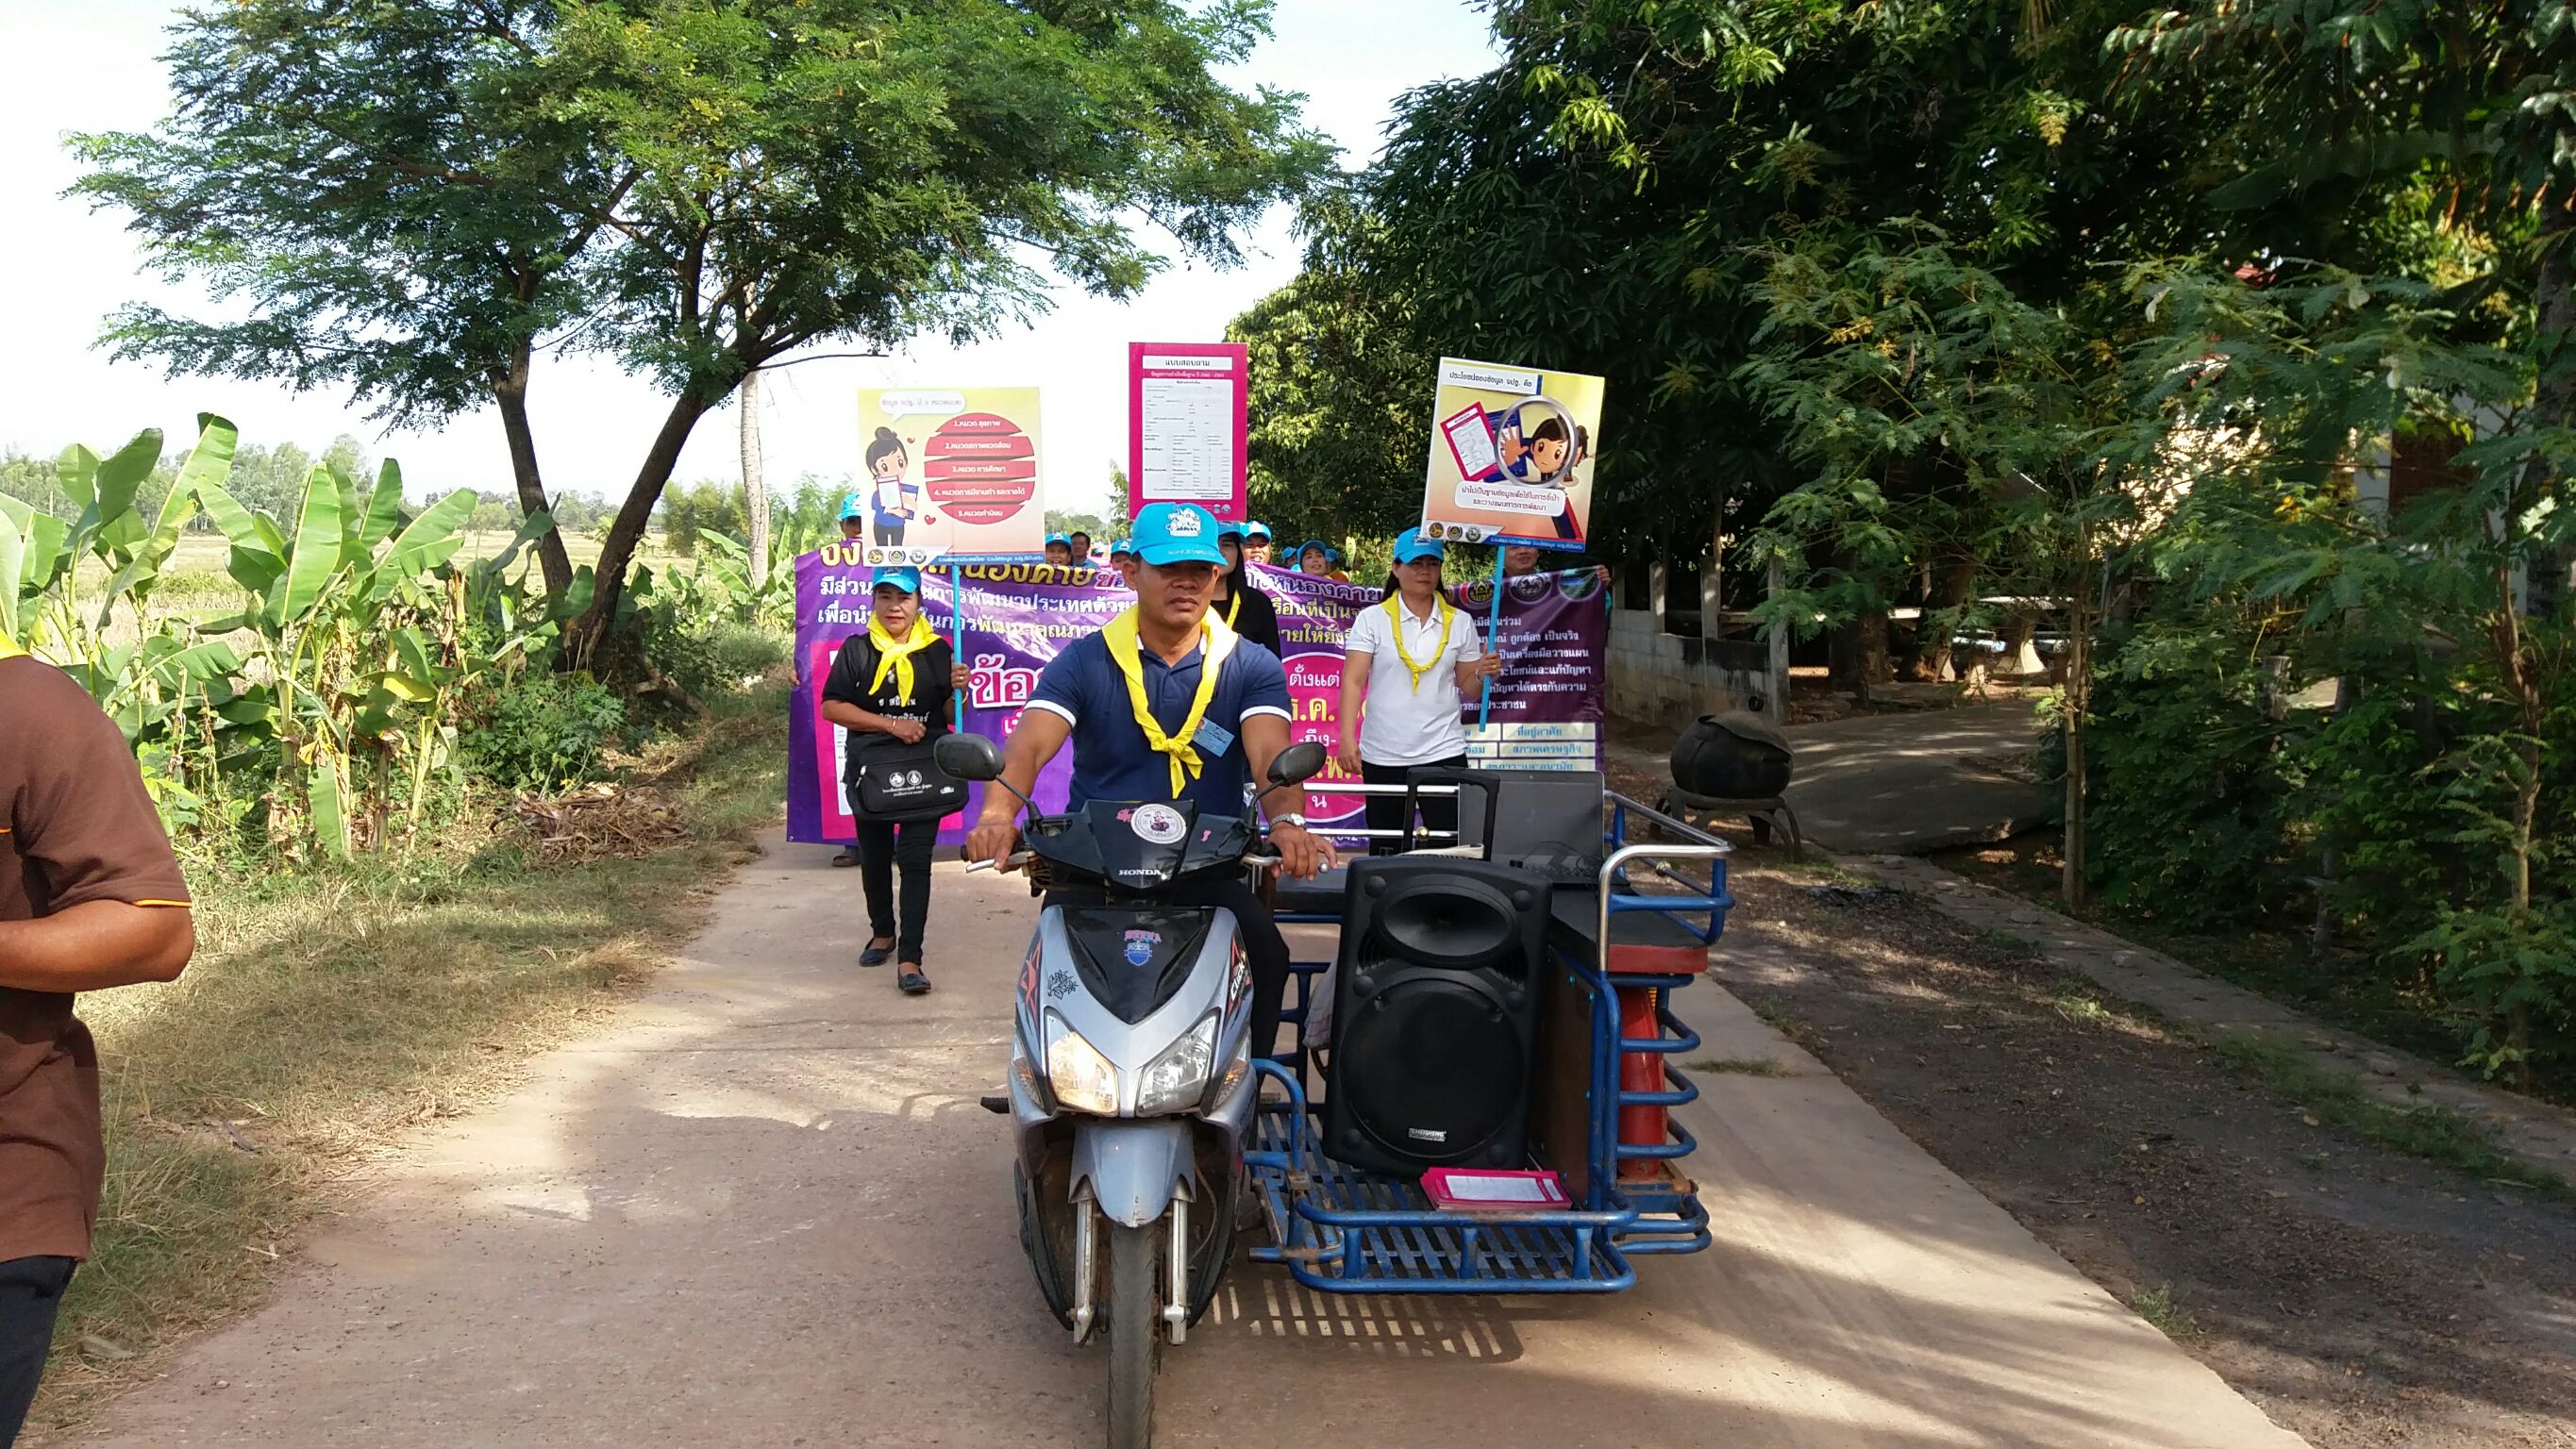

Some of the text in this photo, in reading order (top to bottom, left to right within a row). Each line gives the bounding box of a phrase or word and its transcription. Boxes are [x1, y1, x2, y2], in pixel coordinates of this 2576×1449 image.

[1498, 646, 1590, 660] ป็นเครื่องมือวางแผน
[1289, 662, 1341, 688] ตั้งแต่
[1499, 662, 1592, 676] ระโยชน์และแก้ปัญหา
[968, 654, 1044, 708] ข้อ
[1489, 680, 1587, 694] ปัญหาได้ตรงกับความ
